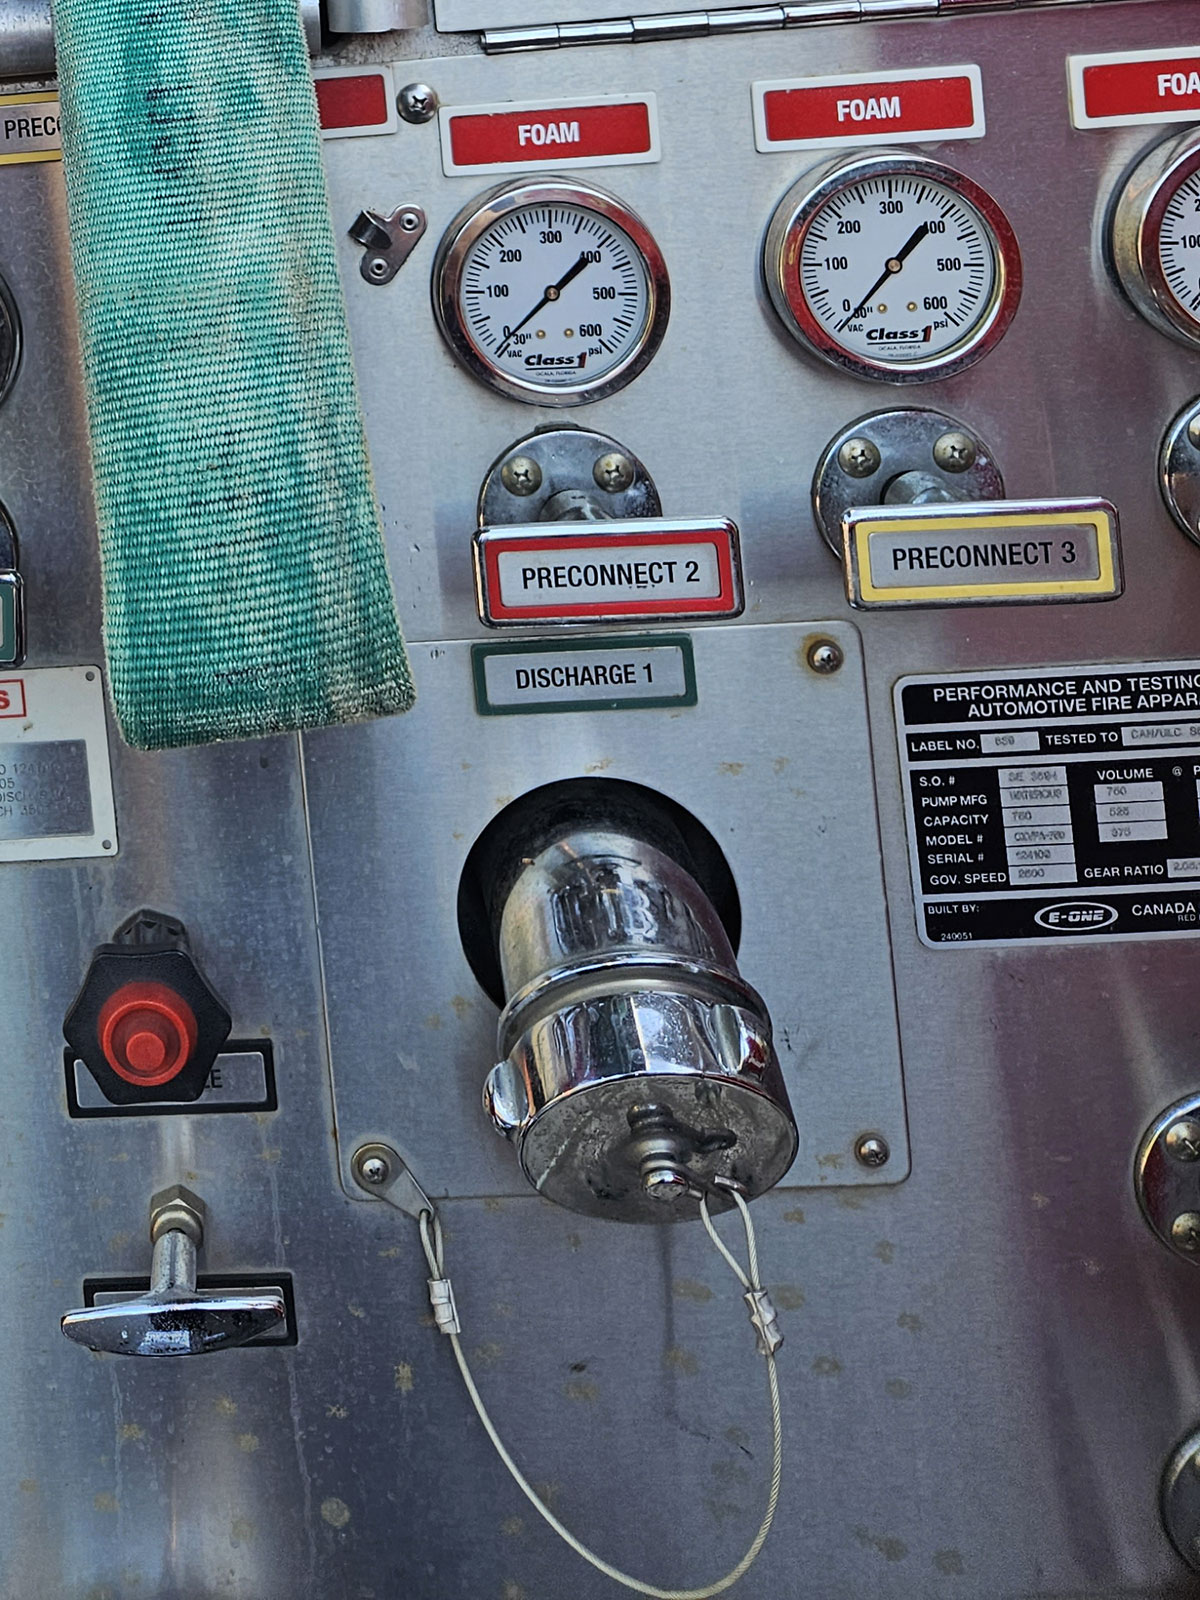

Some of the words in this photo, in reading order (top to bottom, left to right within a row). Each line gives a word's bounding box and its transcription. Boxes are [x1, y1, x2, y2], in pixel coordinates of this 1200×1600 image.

[837, 97, 901, 122] FOAM
[4, 116, 60, 139] PREC
[518, 122, 580, 146] FOAM
[879, 201, 903, 214] 300
[837, 221, 861, 235] 200
[539, 230, 562, 244] 300
[499, 249, 522, 263] 200
[824, 257, 848, 270] 100
[937, 257, 961, 271] 500
[486, 284, 509, 298] 100
[593, 287, 616, 300] 500
[842, 299, 851, 312] 0
[923, 296, 948, 310] 600
[503, 325, 511, 339] 0
[579, 324, 602, 337] 600
[847, 324, 864, 332] VAC
[933, 319, 948, 331] psi
[507, 349, 522, 358] VAC
[588, 346, 603, 357] psi
[892, 542, 1053, 570] PRECONNECT
[1061, 541, 1076, 563] 3
[522, 561, 677, 589] PRECONNECT
[685, 560, 700, 582] 2
[516, 664, 636, 689] DISCHARGE
[643, 663, 653, 683] 1
[933, 681, 1077, 702] PERFORMANCE
[1082, 679, 1122, 694] AND
[968, 698, 1087, 718] AUTOMOTIVE
[1091, 695, 1133, 711] FIRE
[1137, 692, 1200, 709] APPAR
[911, 740, 953, 752] LABEL
[956, 738, 980, 750] NO.
[1045, 733, 1096, 746] TESTED
[1100, 731, 1118, 742] TO
[1097, 768, 1154, 781] VOLUME
[1172, 766, 1183, 777] @
[919, 776, 945, 787] S.O.
[949, 775, 955, 785] #
[921, 796, 957, 807] PUMP
[960, 794, 988, 806] MFG
[923, 814, 989, 827] CAPACITY
[925, 834, 973, 846] MODEL
[977, 834, 983, 843] #
[927, 853, 974, 865] SERIAL
[978, 853, 984, 862] #
[929, 874, 961, 886] GOV.
[964, 872, 1007, 884] SPEED
[1084, 867, 1120, 878] GEAR
[1124, 864, 1164, 876] RATIO
[928, 904, 959, 915] BUILT
[962, 903, 980, 914] BY:
[1132, 902, 1196, 916] CANADA
[1048, 909, 1104, 924] E-ONE
[1178, 914, 1196, 922] RED
